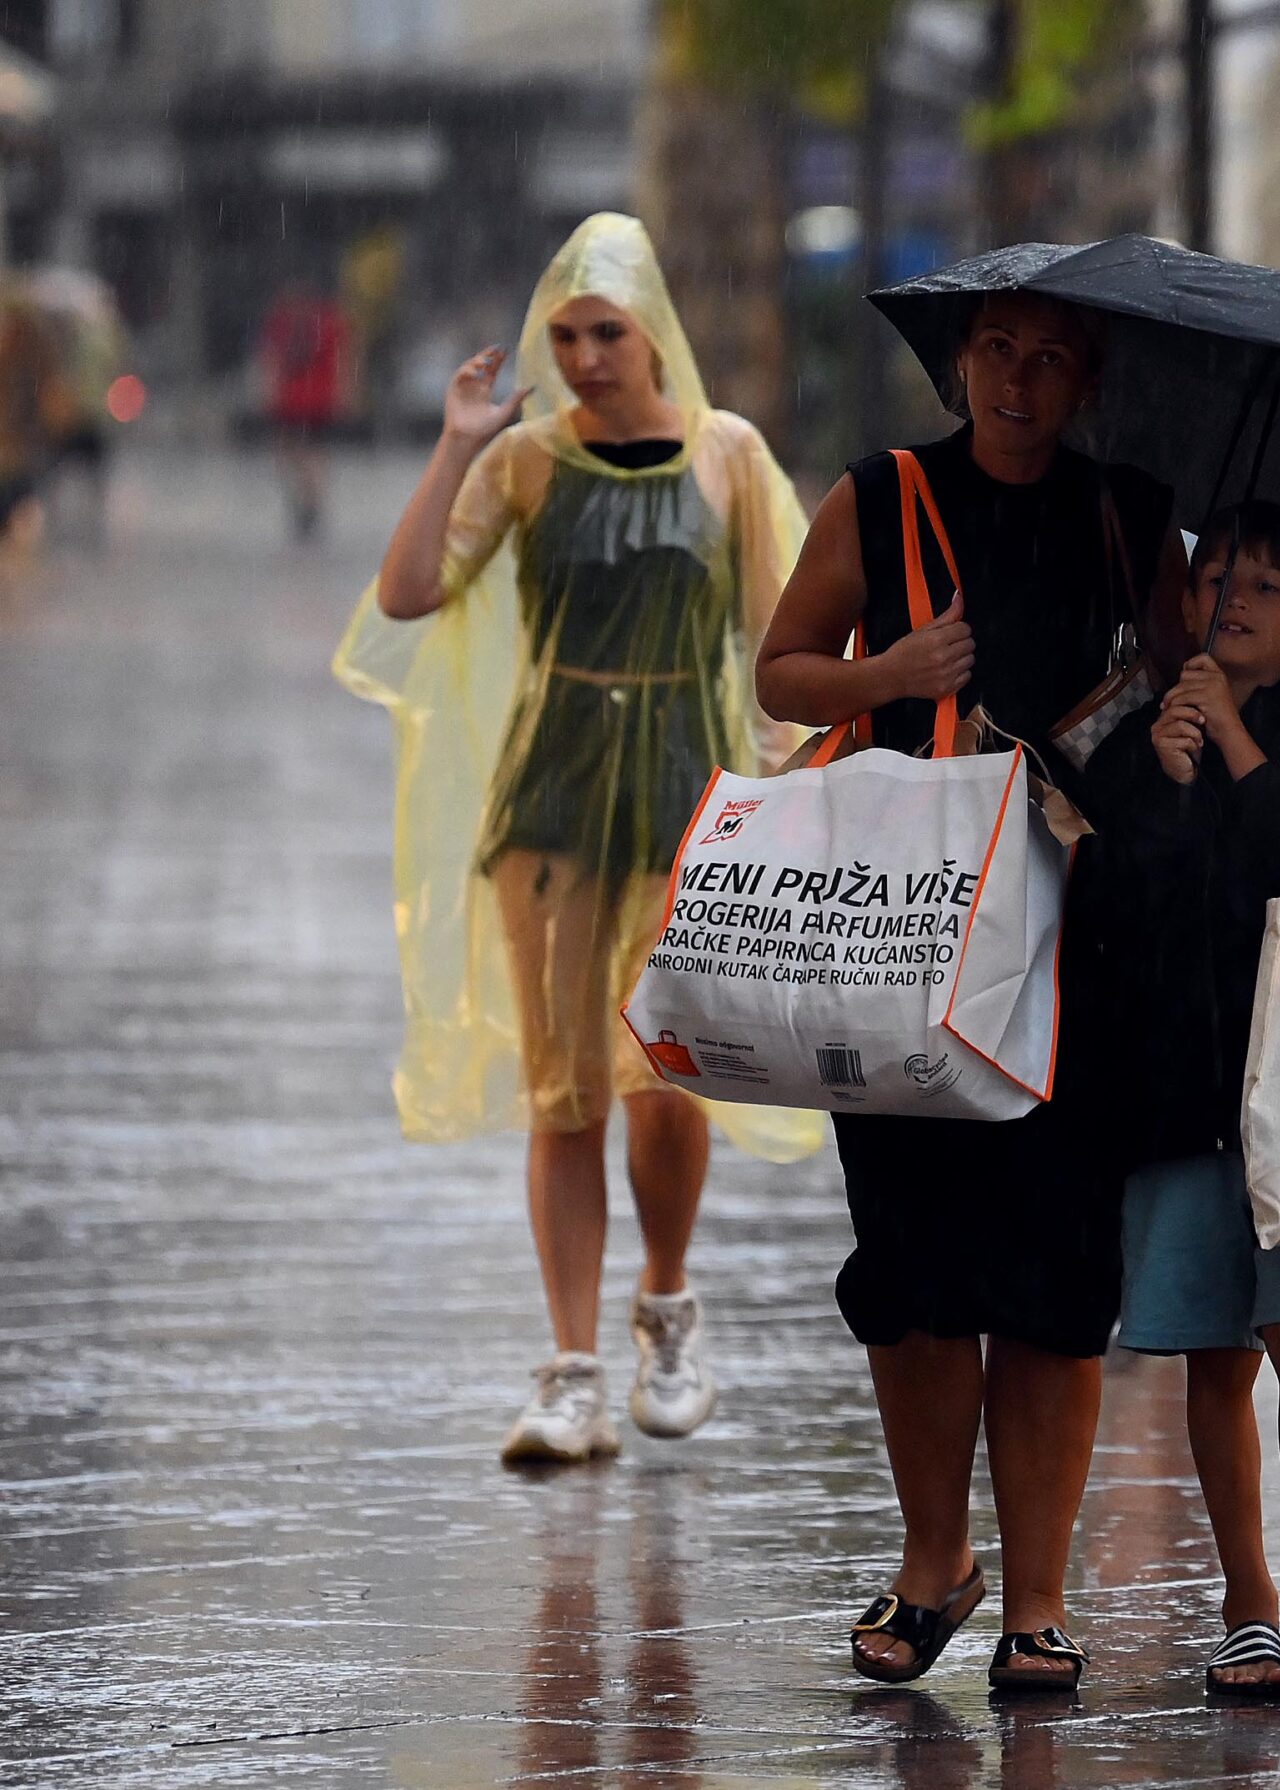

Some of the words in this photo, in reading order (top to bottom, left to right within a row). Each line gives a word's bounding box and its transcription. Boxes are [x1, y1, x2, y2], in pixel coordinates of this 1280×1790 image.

[905, 858, 980, 907] VIŠE
[657, 925, 732, 954] RAČKE
[716, 960, 769, 980] KUTAK
[830, 967, 880, 986] RUČNI
[884, 970, 917, 986] RAD
